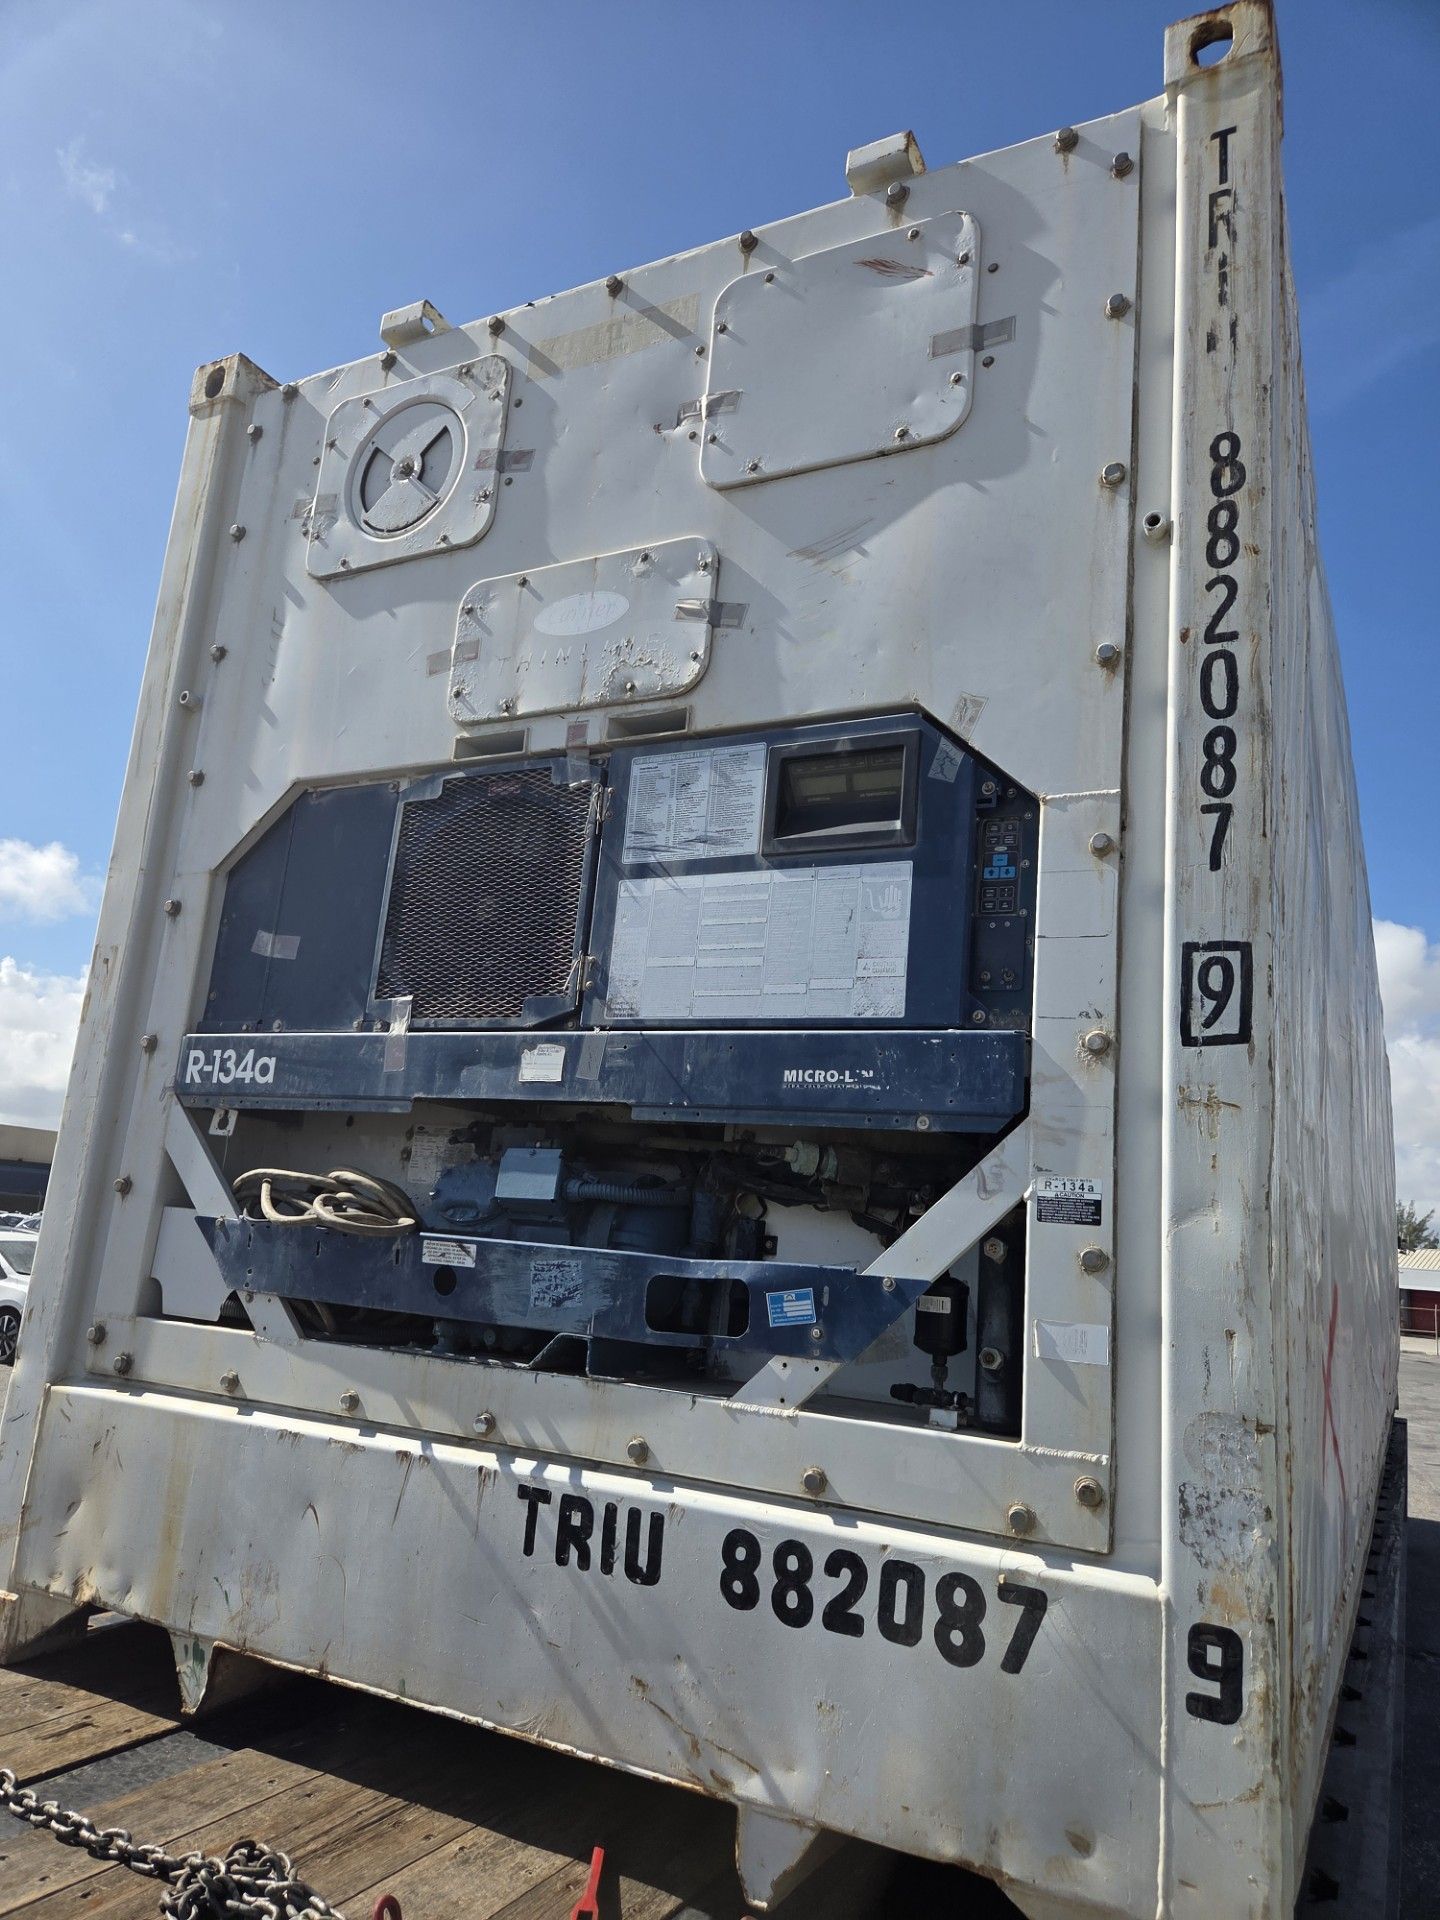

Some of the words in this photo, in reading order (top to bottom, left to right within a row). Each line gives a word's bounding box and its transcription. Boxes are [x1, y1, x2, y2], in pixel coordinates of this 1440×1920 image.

[1200, 431, 1247, 872] 882087
[1198, 956, 1235, 1029] 9
[185, 1049, 277, 1084] R-134a
[1044, 1180, 1094, 1192] R-134a
[517, 1483, 665, 1586] TRIU
[720, 1528, 1049, 1675] 882087
[1186, 1622, 1243, 1725] 9
